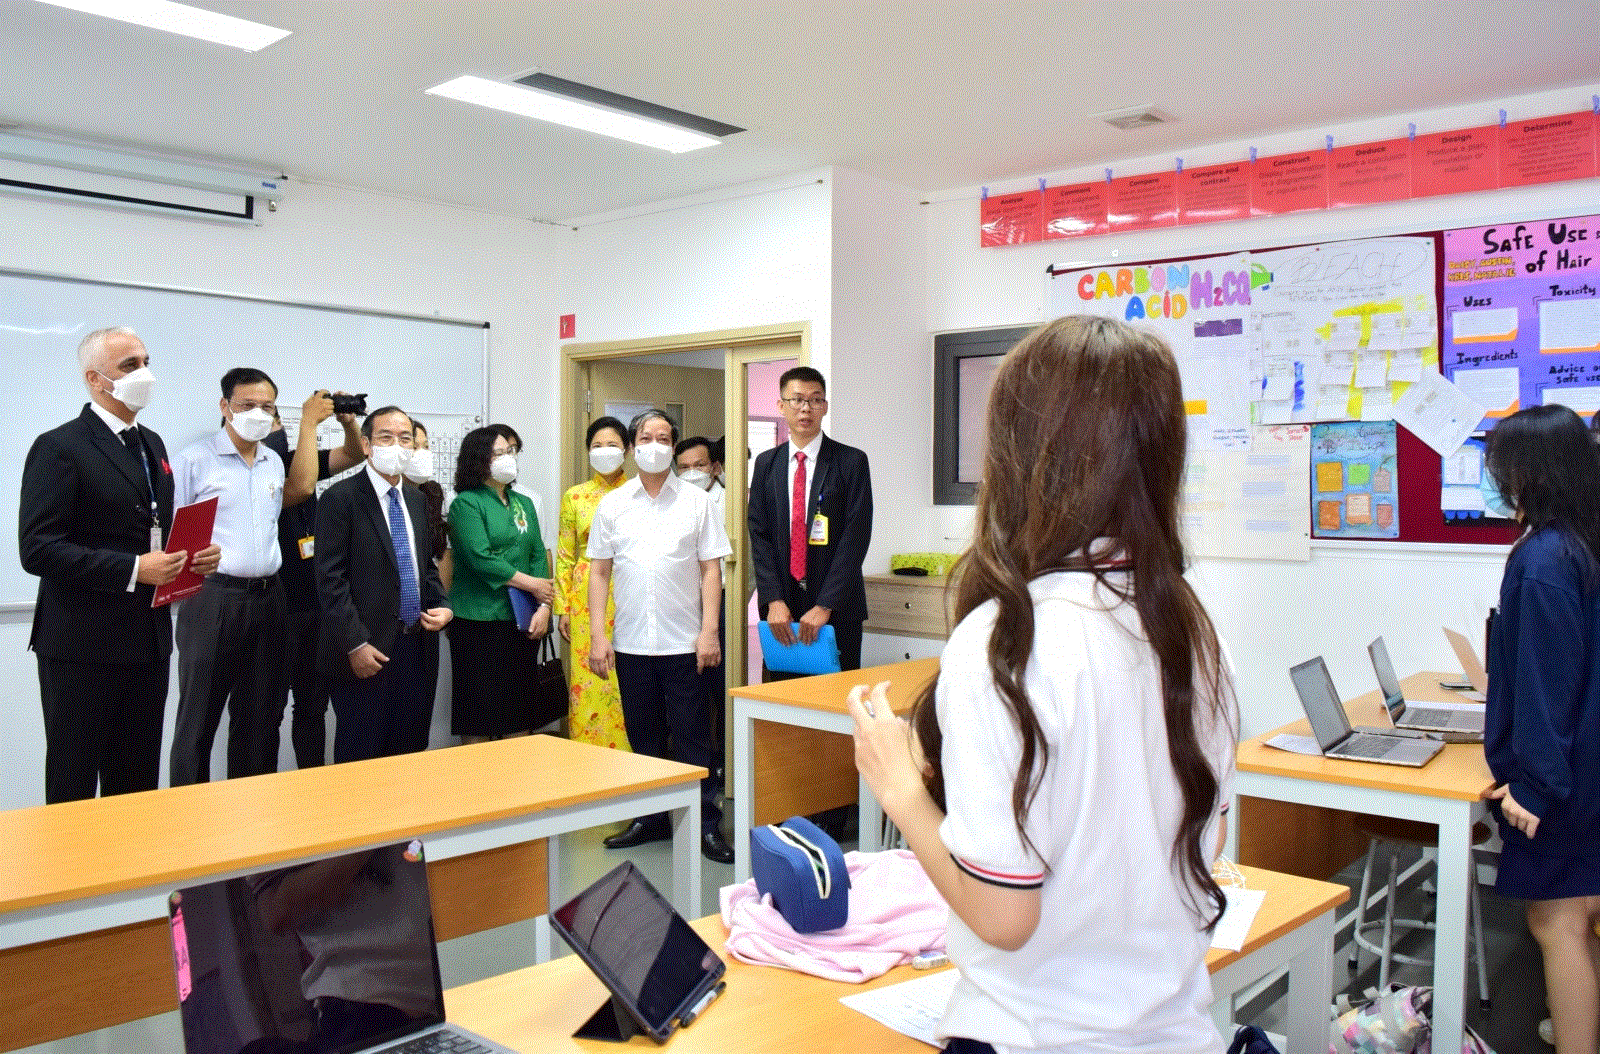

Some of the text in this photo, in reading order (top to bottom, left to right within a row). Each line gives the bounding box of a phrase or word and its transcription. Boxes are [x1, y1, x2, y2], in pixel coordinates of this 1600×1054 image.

[1524, 119, 1572, 132] Determine
[1442, 133, 1472, 145] Design
[1356, 146, 1385, 156] Deduce
[1273, 156, 1310, 167] Construct
[1192, 169, 1223, 179] Compare
[1201, 177, 1230, 186] contrast
[1525, 250, 1548, 273] of
[1077, 264, 1190, 300] CARBON
[1549, 284, 1596, 296] Toxicity
[1457, 349, 1518, 366] Ingredients
[1549, 363, 1585, 374] Advice
